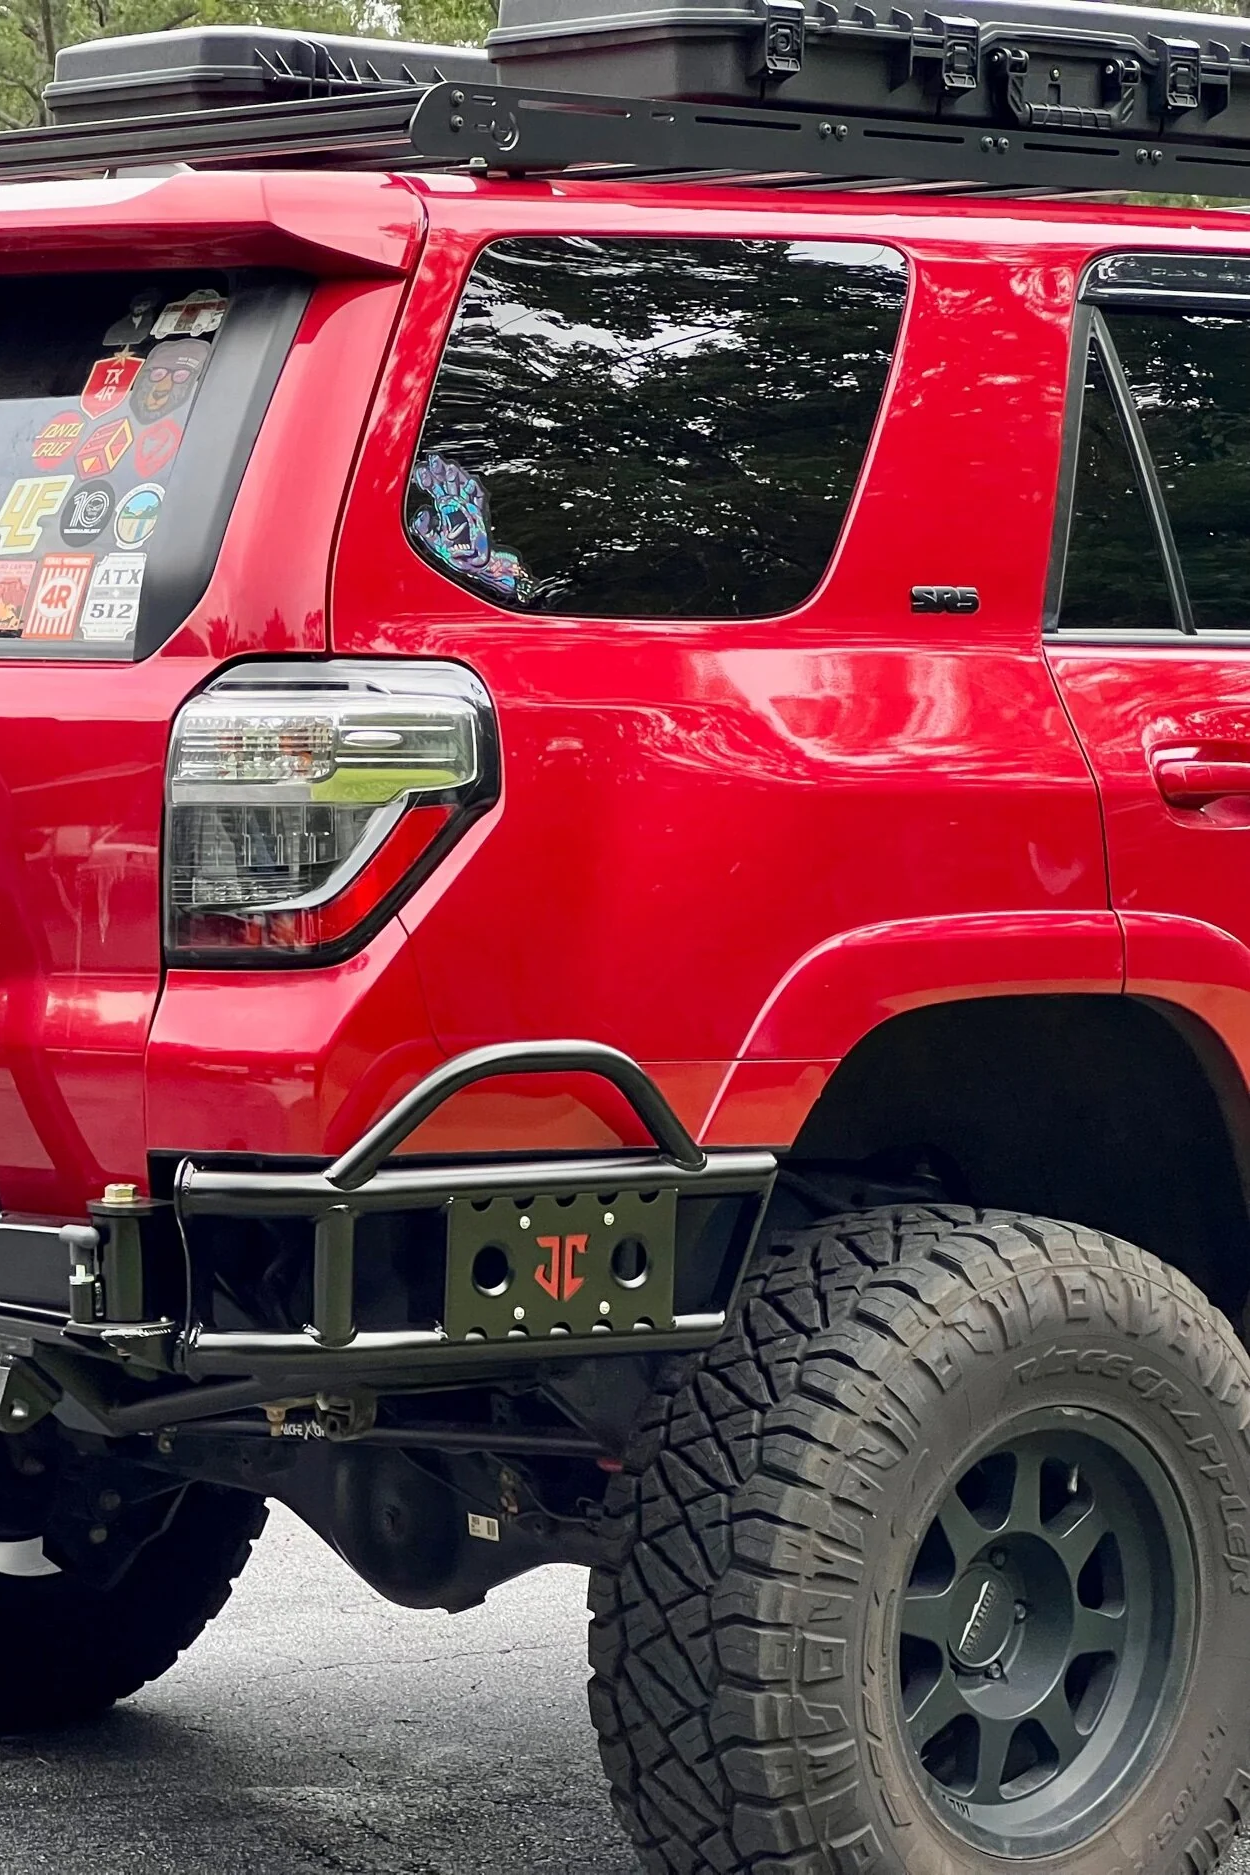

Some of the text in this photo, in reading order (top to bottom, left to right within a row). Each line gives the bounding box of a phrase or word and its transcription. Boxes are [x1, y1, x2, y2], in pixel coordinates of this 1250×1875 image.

[104, 368, 125, 385] TX
[94, 385, 116, 402] 4R
[35, 422, 86, 439] SANTA
[31, 441, 72, 458] CRUZ
[69, 490, 111, 528] 10
[97, 568, 143, 585] ATX
[40, 584, 72, 609] 4R
[910, 585, 981, 614] SR5
[90, 603, 134, 619] 512
[961, 1581, 998, 1658] METHOD
